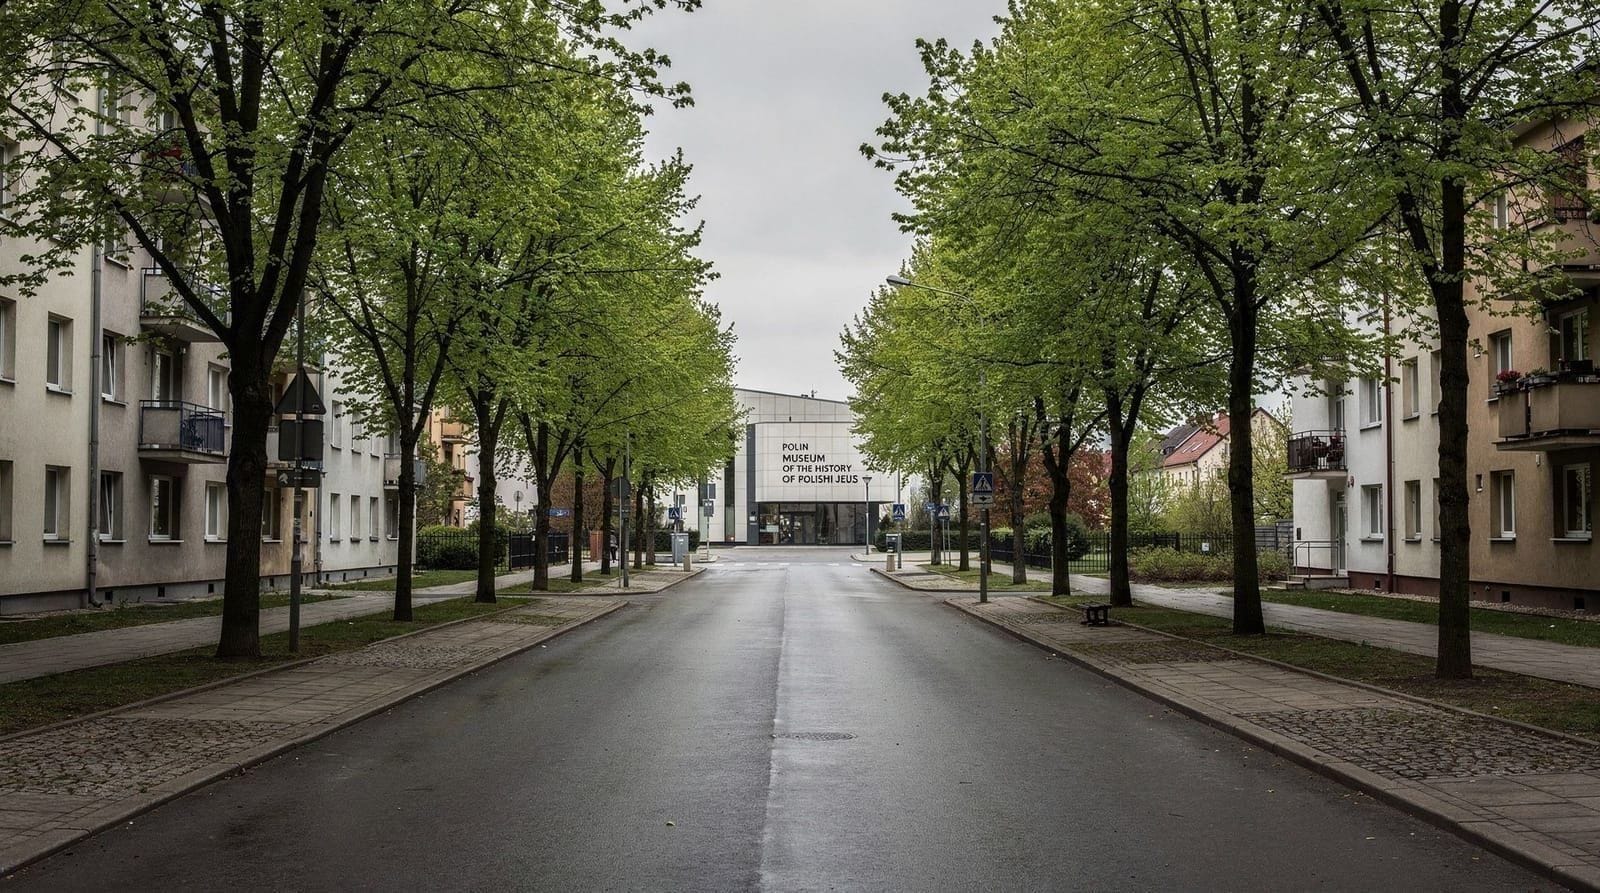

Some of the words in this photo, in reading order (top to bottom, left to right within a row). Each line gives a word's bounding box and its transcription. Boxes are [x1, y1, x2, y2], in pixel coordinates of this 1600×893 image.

[782, 443, 809, 451] POLIN
[782, 454, 825, 463] MUSEUM
[782, 464, 795, 473] OF
[796, 464, 813, 473] THE
[815, 464, 852, 473] HISTORY
[782, 475, 796, 484] OF
[835, 474, 859, 484] JEUS
